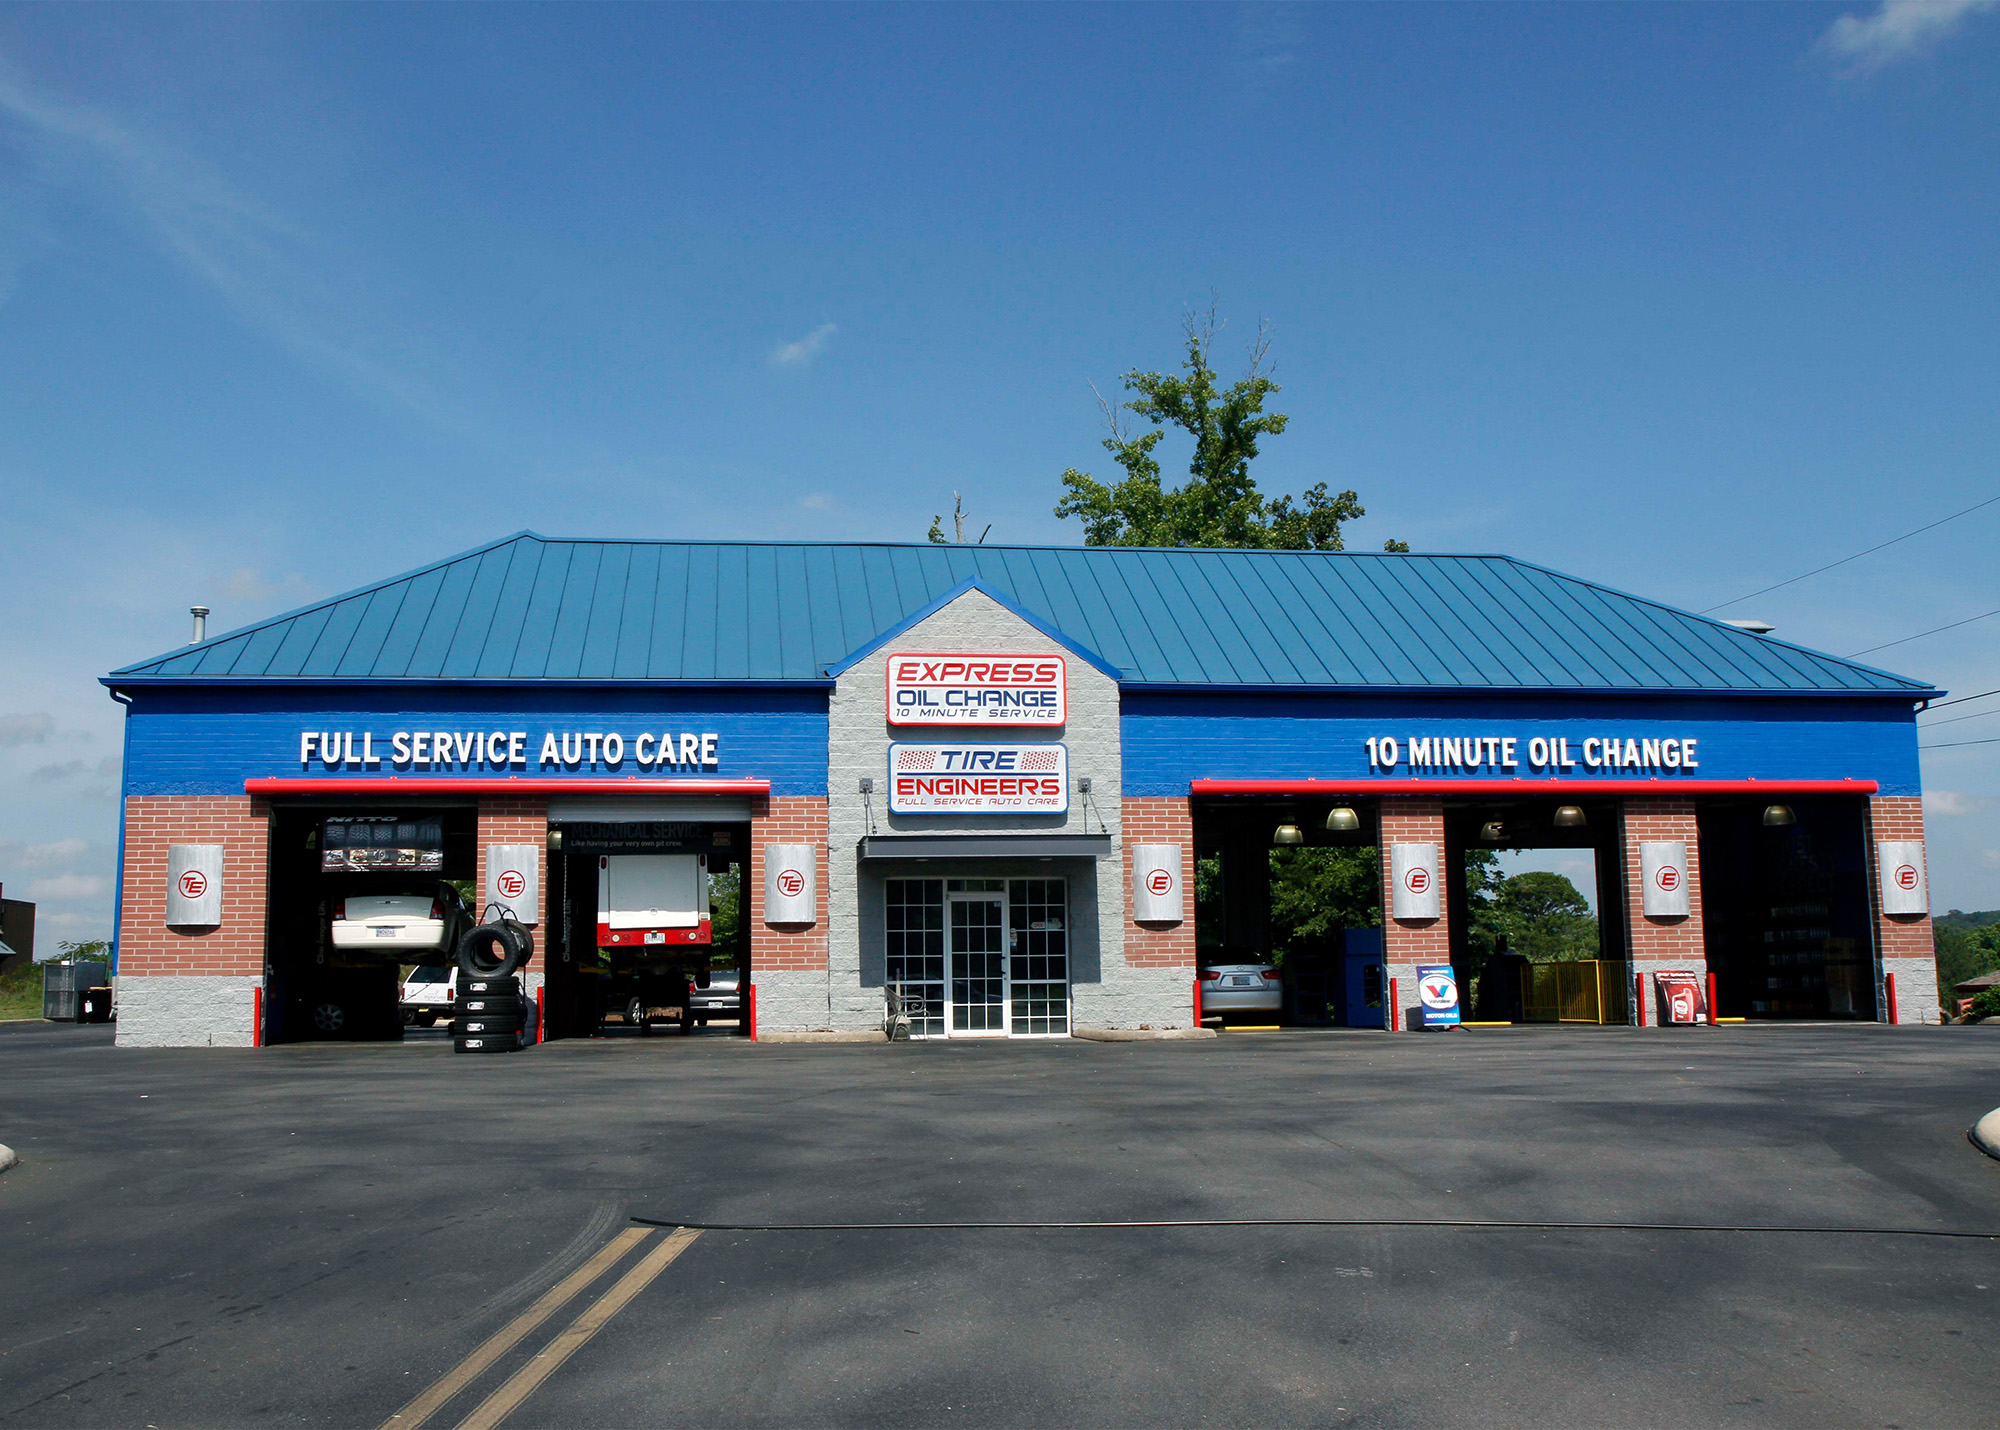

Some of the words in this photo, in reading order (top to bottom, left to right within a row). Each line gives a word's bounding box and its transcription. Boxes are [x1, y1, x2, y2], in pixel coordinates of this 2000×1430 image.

[897, 662, 1059, 682] EXPRESS
[897, 690, 939, 707] OIL
[945, 690, 1057, 707] CHANGE
[896, 708, 910, 717] 10
[919, 708, 979, 718] MINUTE
[988, 708, 1057, 718] SERVICE
[300, 731, 381, 764] FULL
[391, 731, 527, 764] SERVICE
[539, 732, 625, 765] AUTO
[635, 732, 719, 765] CARE
[1366, 736, 1399, 767] 10
[1409, 736, 1519, 767] MINUTE
[1528, 736, 1576, 767] OIL
[1583, 737, 1699, 768] CHANGE
[940, 751, 1018, 770] TIRE
[896, 778, 1061, 796] ENGINEERS
[897, 798, 927, 806] FULL
[934, 798, 982, 806] SERVICE
[988, 798, 1022, 806] AUTO
[1027, 798, 1059, 806] CARE
[571, 822, 650, 839] MECHANICAL
[586, 840, 609, 848] having
[655, 840, 665, 848] pit
[182, 876, 205, 894] TE
[500, 876, 524, 893] TE
[781, 876, 803, 892] TE
[315, 916, 328, 965] Chalenger
